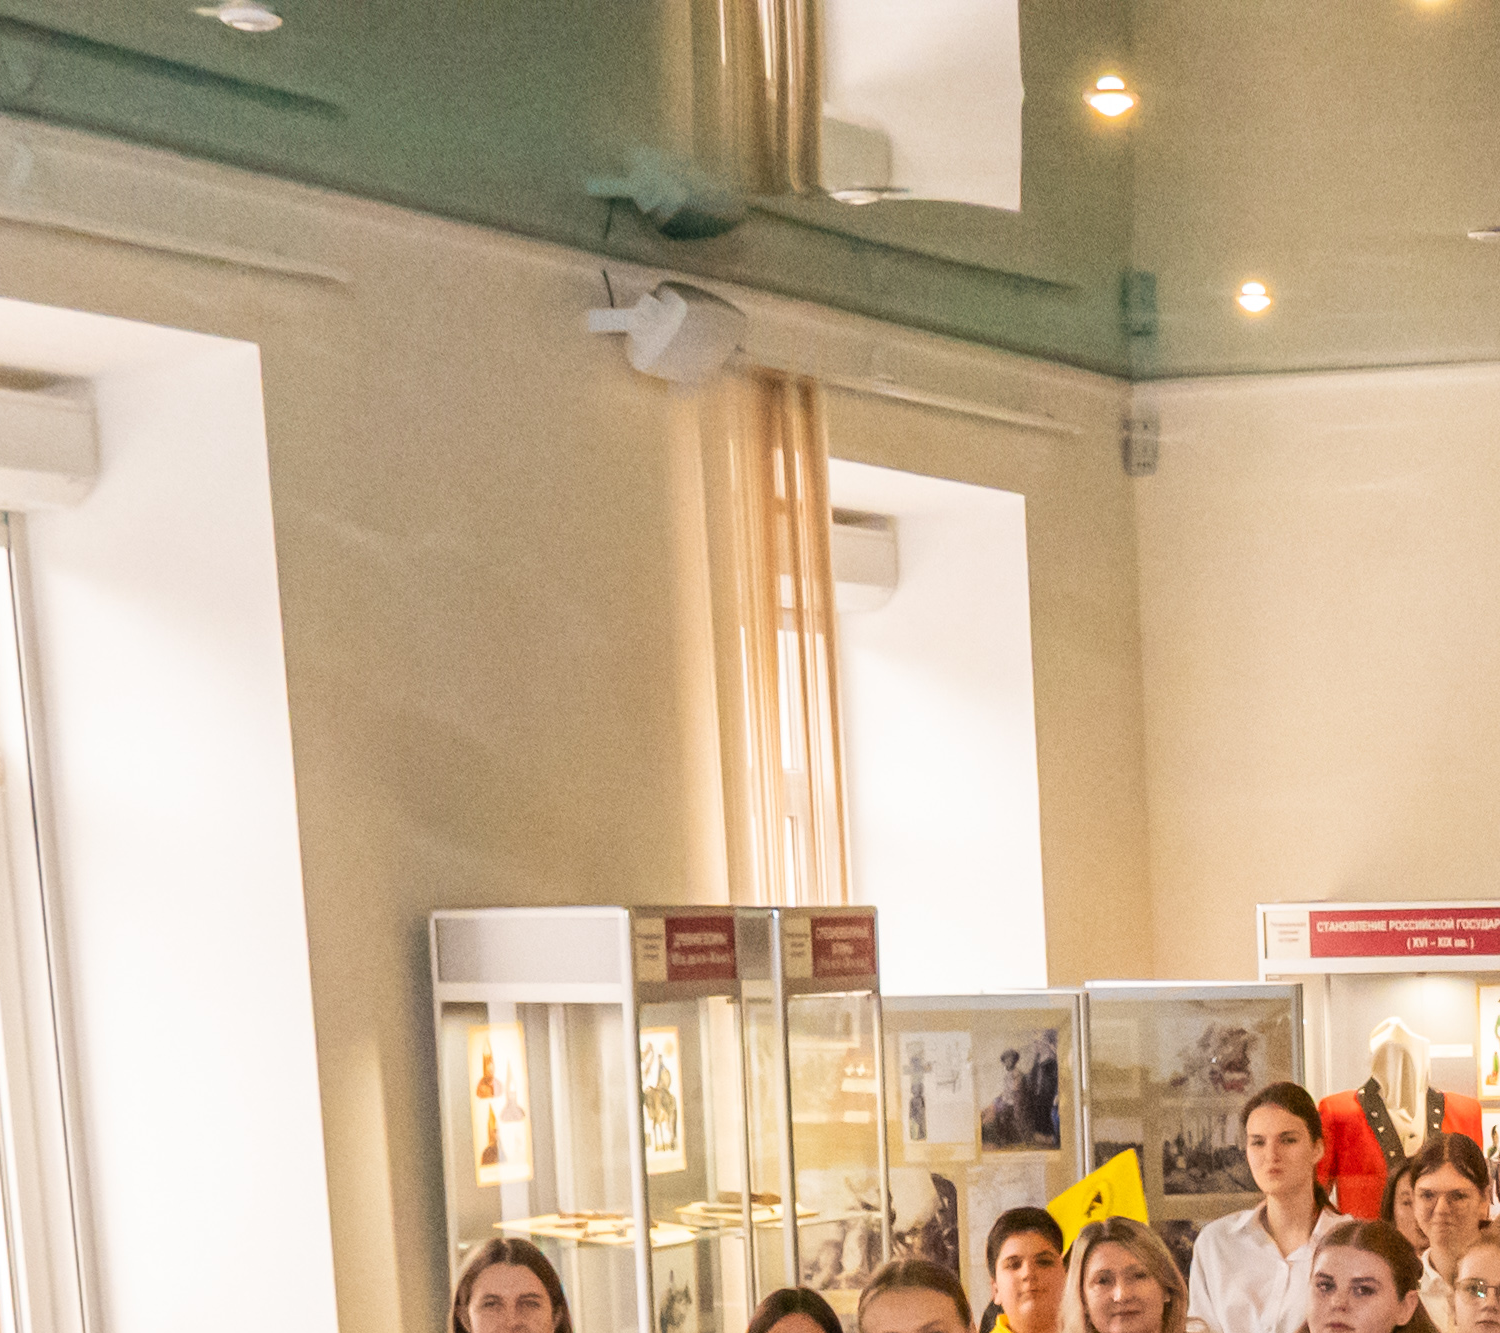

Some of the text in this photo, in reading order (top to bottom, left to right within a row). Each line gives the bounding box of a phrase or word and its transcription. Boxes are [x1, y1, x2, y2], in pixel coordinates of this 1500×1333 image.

[1316, 919, 1387, 932] СТАНОВЛЕНИЕ
[1388, 917, 1455, 931] РОССИЙСКОЙ
[1412, 938, 1428, 948] XVI
[1437, 938, 1453, 948] XIX
